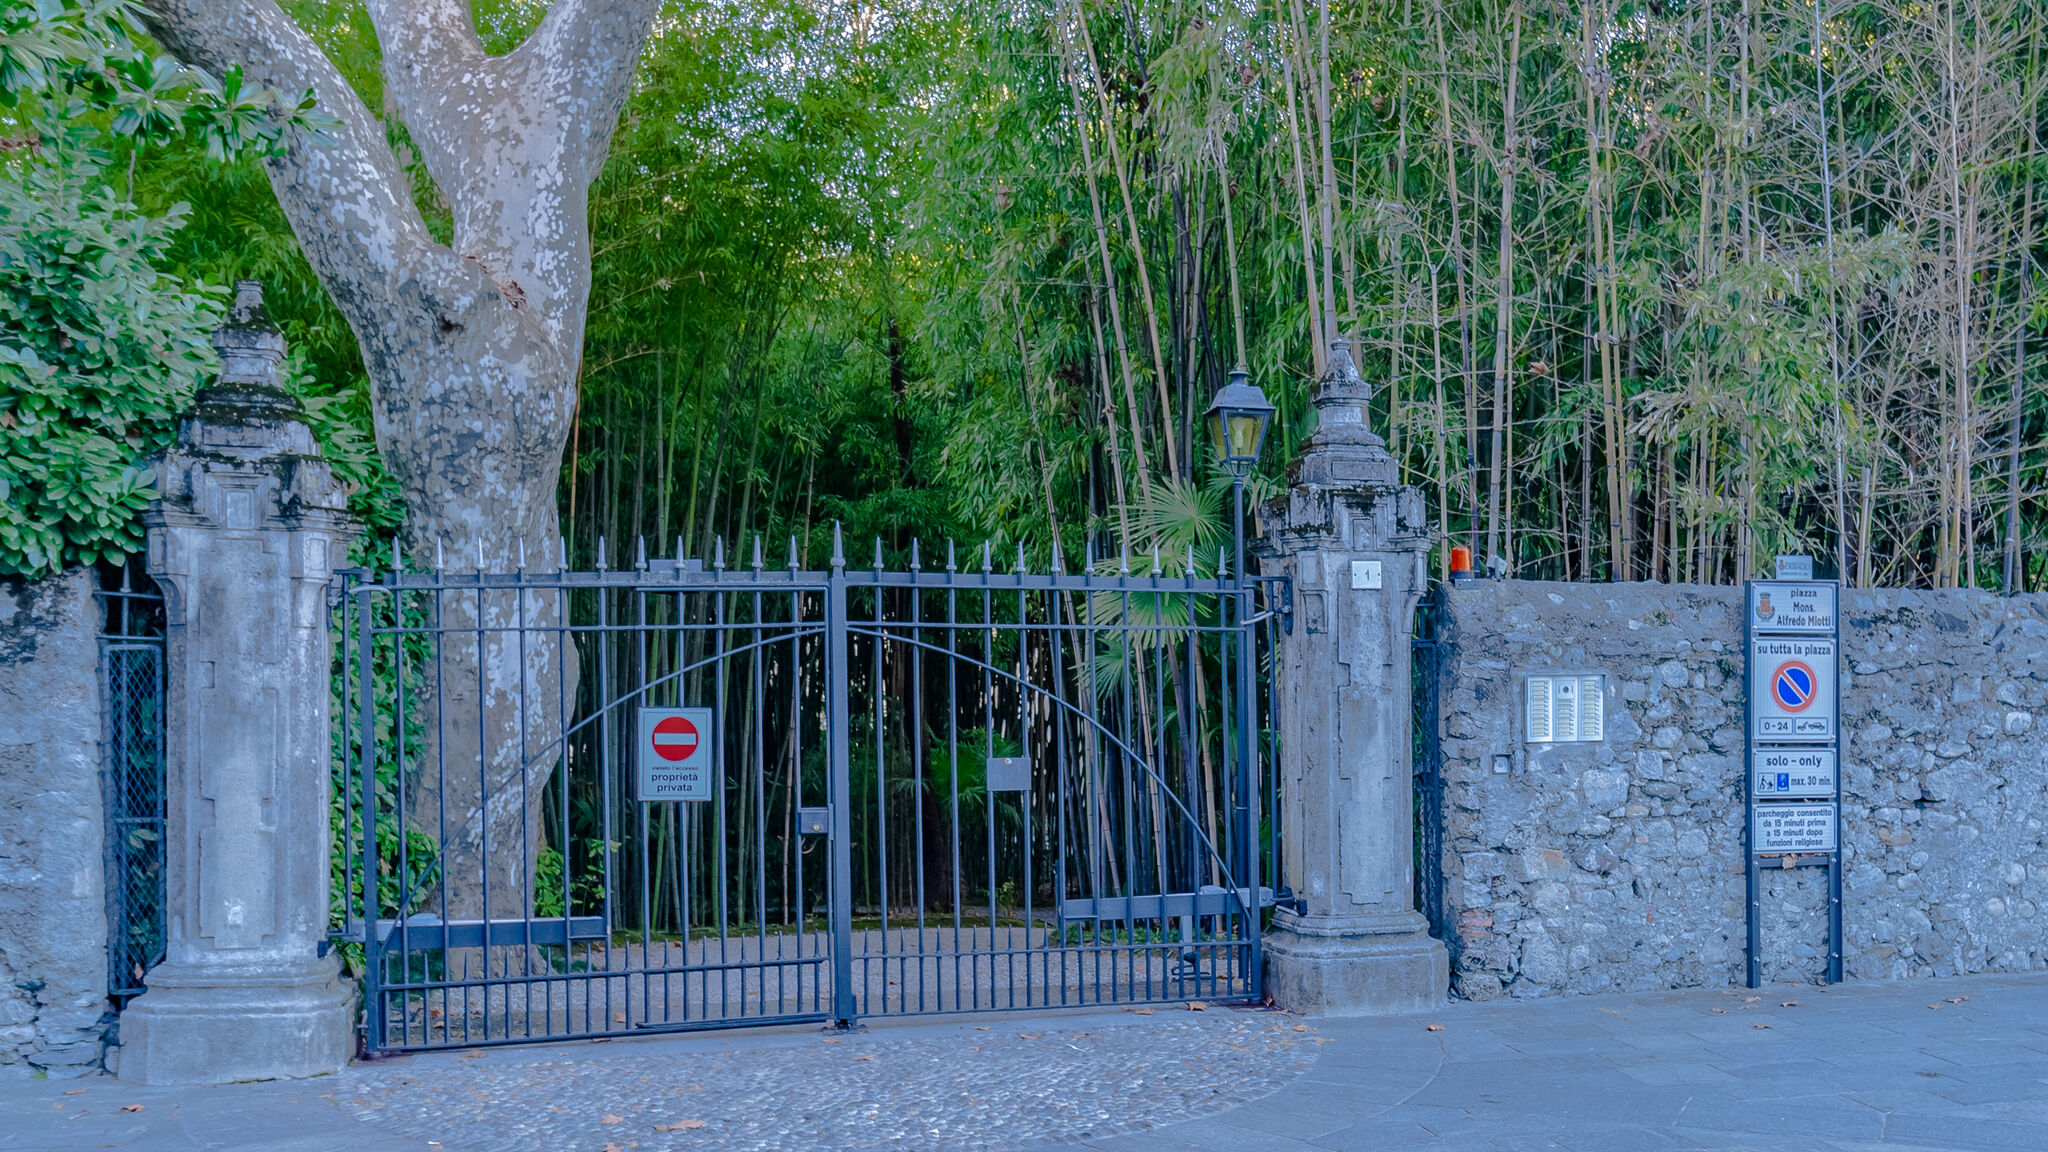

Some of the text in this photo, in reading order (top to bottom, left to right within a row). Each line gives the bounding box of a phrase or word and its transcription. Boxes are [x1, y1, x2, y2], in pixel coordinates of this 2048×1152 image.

[1365, 569, 1370, 581] 1
[1790, 588, 1817, 598] piazza
[1793, 601, 1816, 613] Mons.
[1776, 615, 1831, 627] Alfredo Miotti
[1757, 643, 1831, 656] su tutta la piazza
[1777, 722, 1788, 731] 24
[1766, 755, 1789, 766] solo
[1799, 755, 1822, 767] only
[651, 772, 699, 782] proprietà
[1790, 776, 1832, 786] max. 30 min.
[657, 783, 693, 793] privata
[1757, 808, 1832, 818] parcheggio consentito
[1763, 818, 1826, 827] da 15 minuti prima
[1773, 829, 1781, 837] 15
[1783, 828, 1804, 837] minuti
[1806, 828, 1823, 837] dopo
[1766, 838, 1823, 847] funzioni religiose
